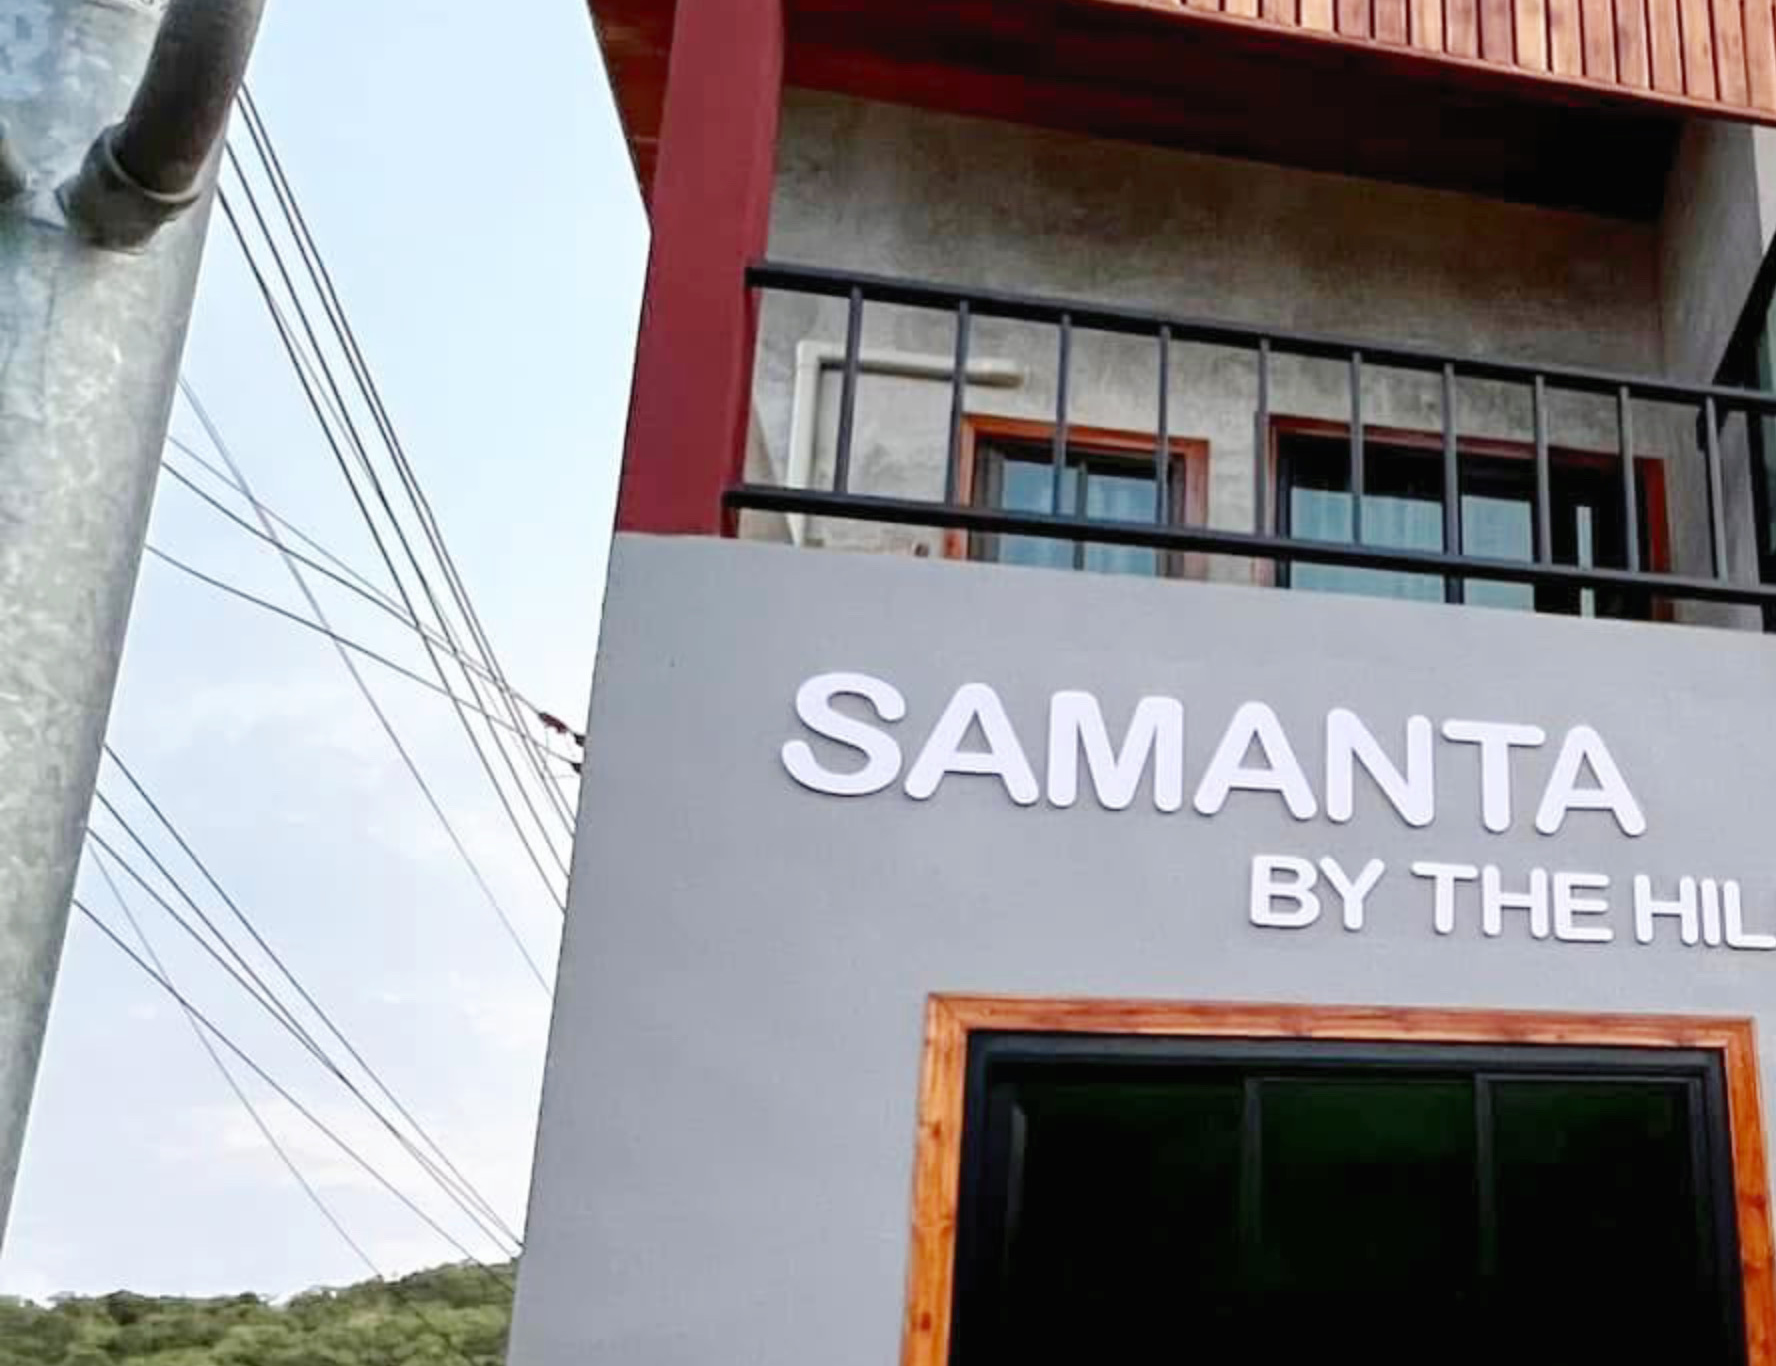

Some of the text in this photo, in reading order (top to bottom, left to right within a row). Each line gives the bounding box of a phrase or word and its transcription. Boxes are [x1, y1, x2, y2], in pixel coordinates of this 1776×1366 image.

[781, 672, 1647, 837] SAMANTA
[1250, 854, 1385, 931] BY
[1411, 861, 1614, 942] THE
